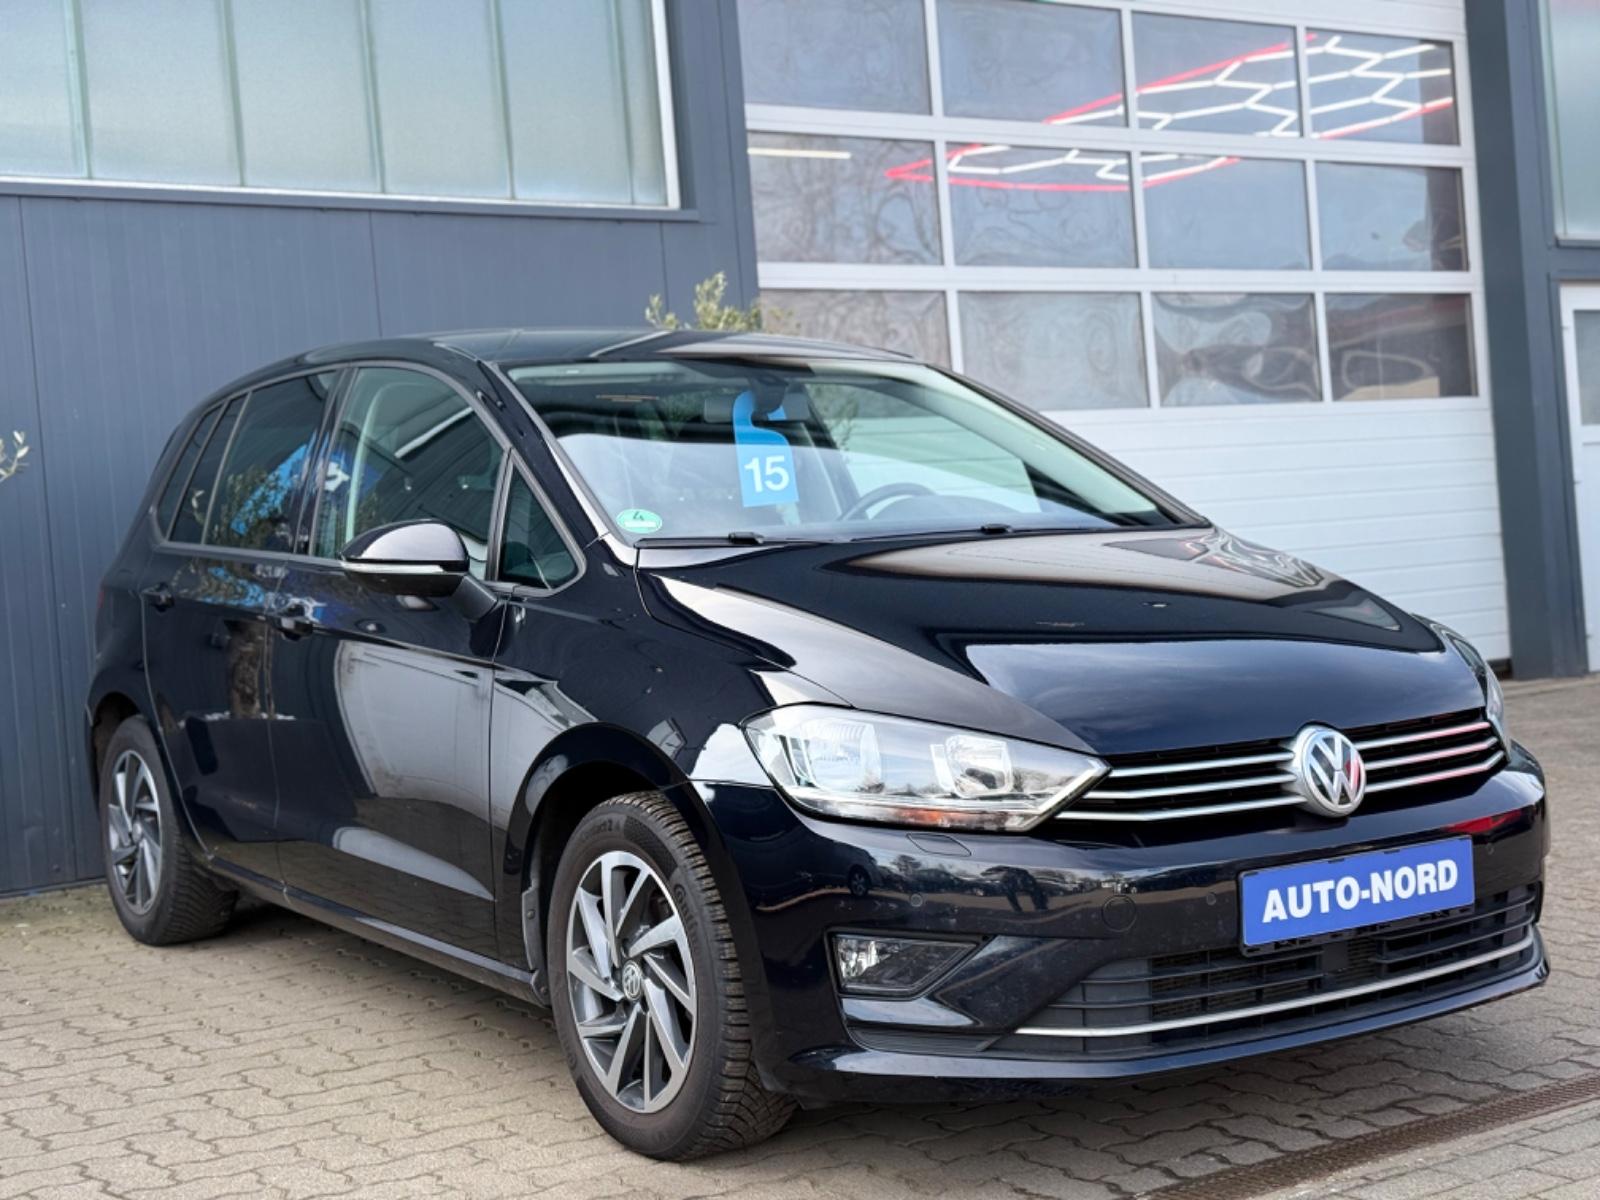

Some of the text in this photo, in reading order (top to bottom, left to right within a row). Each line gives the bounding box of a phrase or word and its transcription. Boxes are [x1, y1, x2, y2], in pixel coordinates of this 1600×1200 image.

[743, 455, 790, 493] 15
[1303, 730, 1366, 812] VW
[1262, 859, 1458, 923] AUTO-NORD
